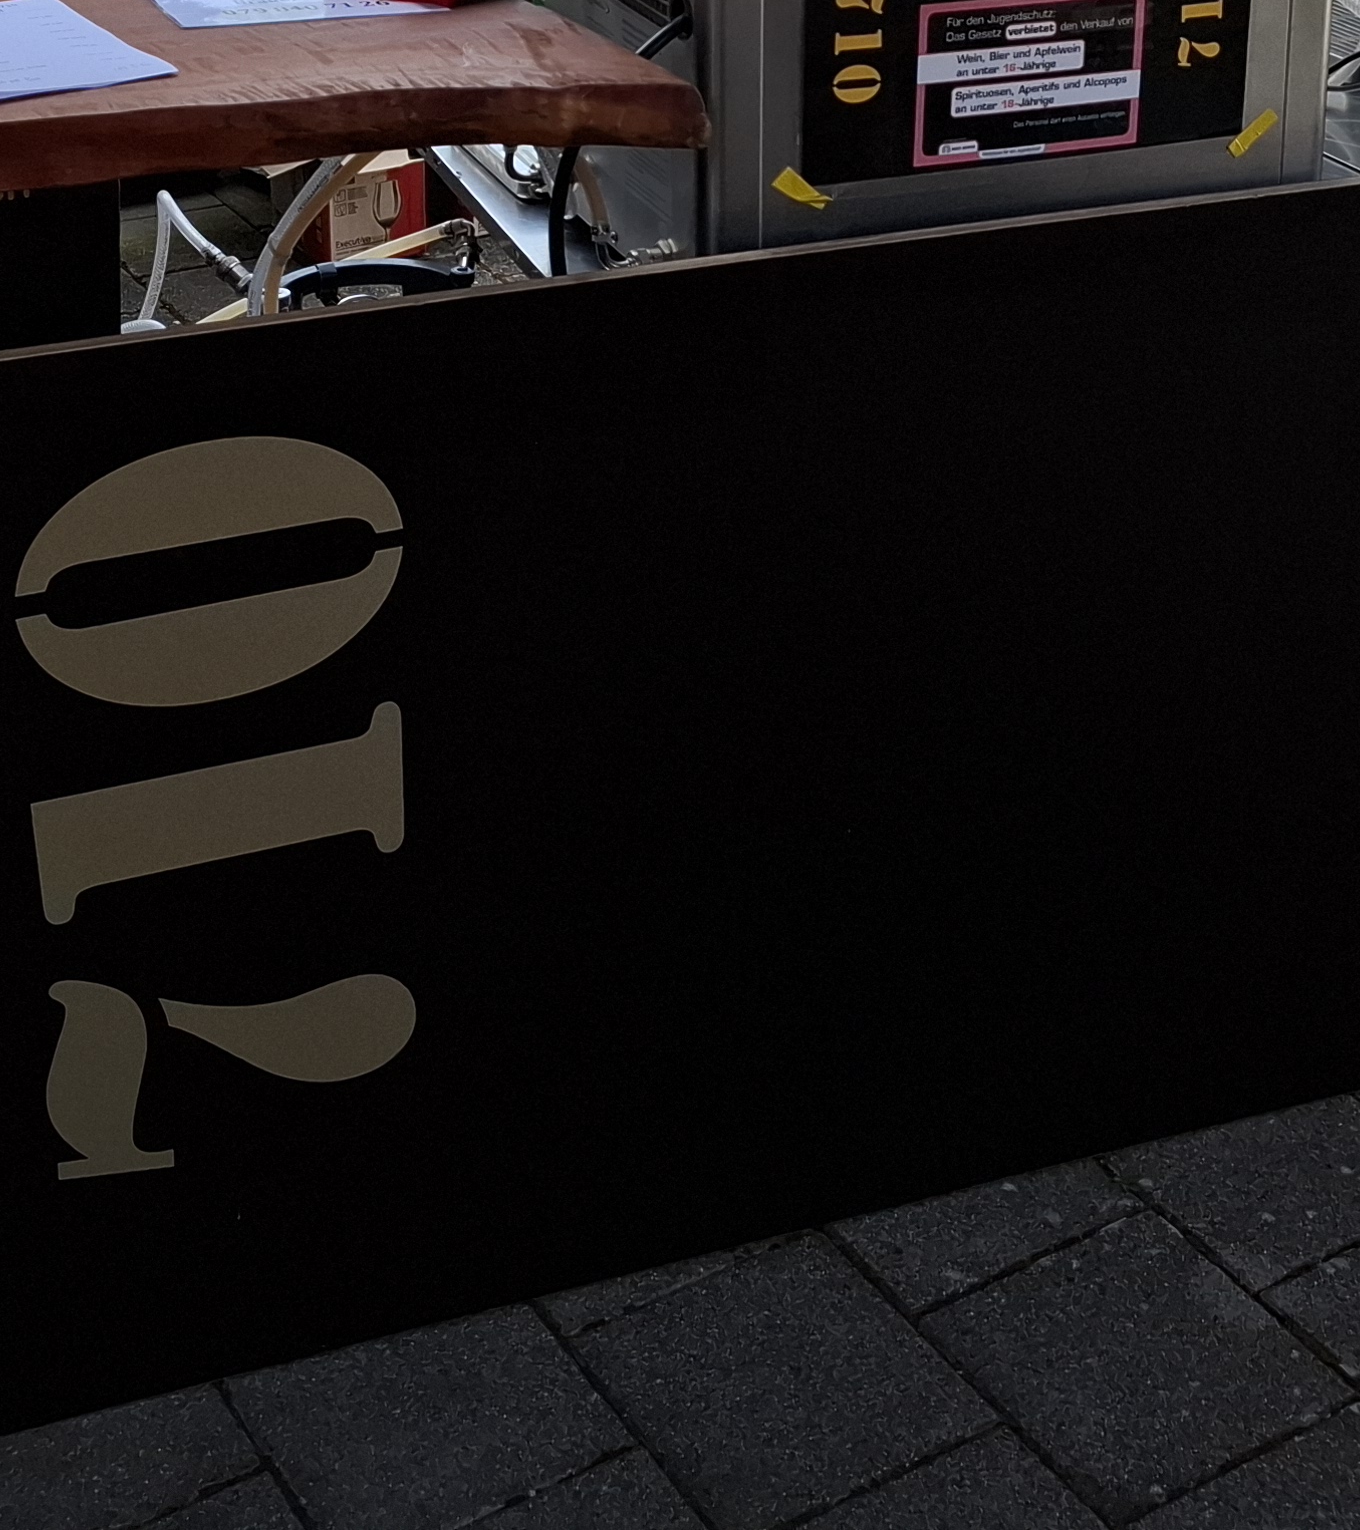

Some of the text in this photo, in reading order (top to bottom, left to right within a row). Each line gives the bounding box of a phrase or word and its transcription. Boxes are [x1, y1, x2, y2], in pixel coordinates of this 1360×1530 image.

[1013, 48, 1031, 58] und
[1063, 80, 1081, 90] und
[1084, 75, 1128, 88] Alcopops
[14, 435, 418, 1181] 710
